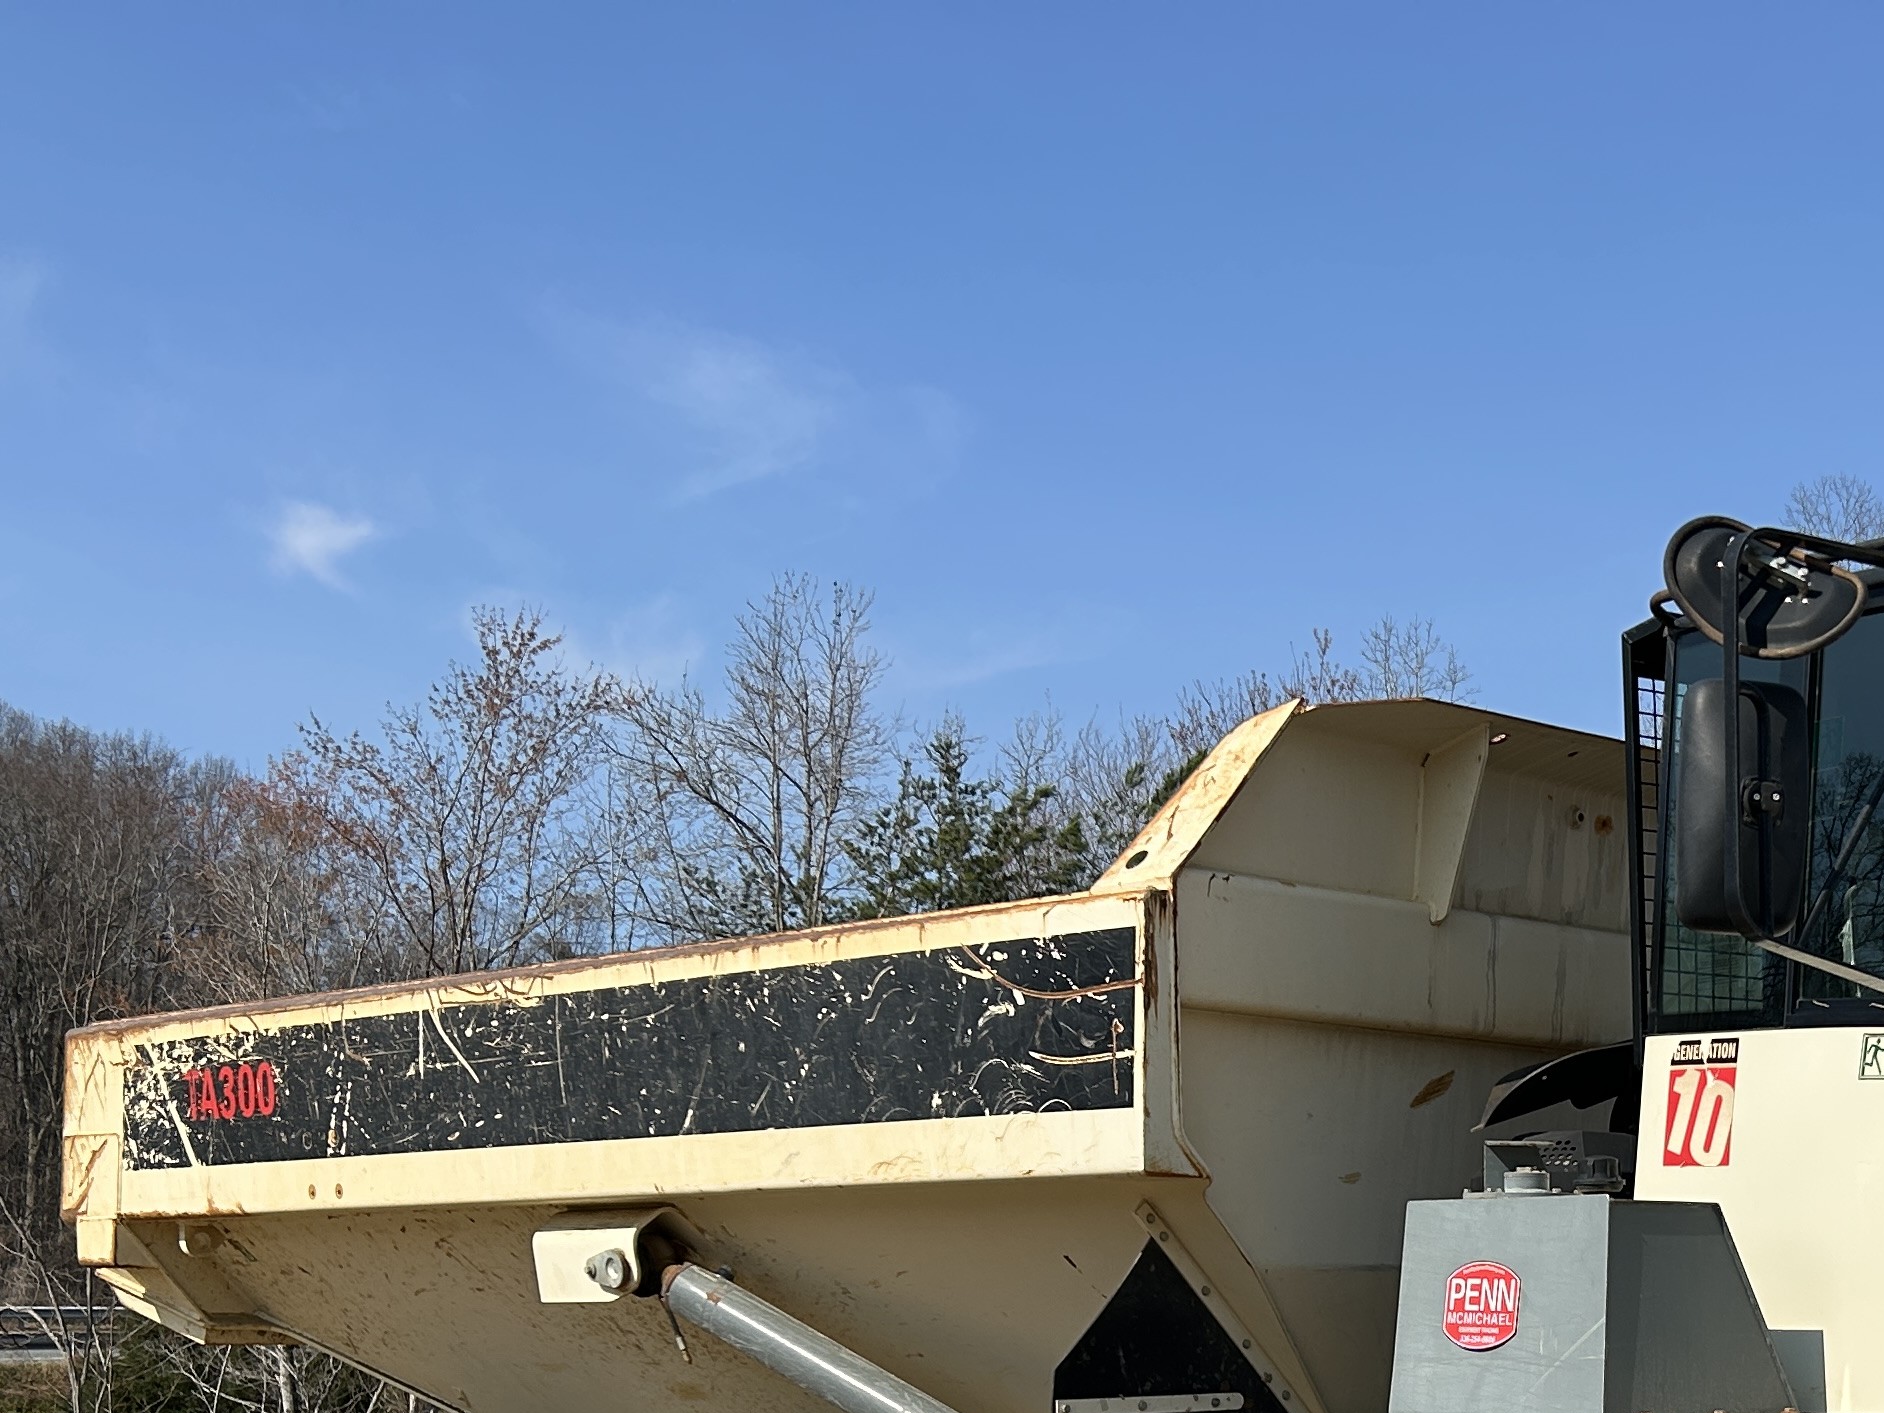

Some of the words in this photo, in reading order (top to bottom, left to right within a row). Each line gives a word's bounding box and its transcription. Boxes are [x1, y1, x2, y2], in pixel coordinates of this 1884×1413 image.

[183, 1062, 275, 1121] TA300
[1667, 1068, 1735, 1167] 10
[1449, 1278, 1516, 1312] PENN
[1446, 1312, 1513, 1326] MCMICHAEL
